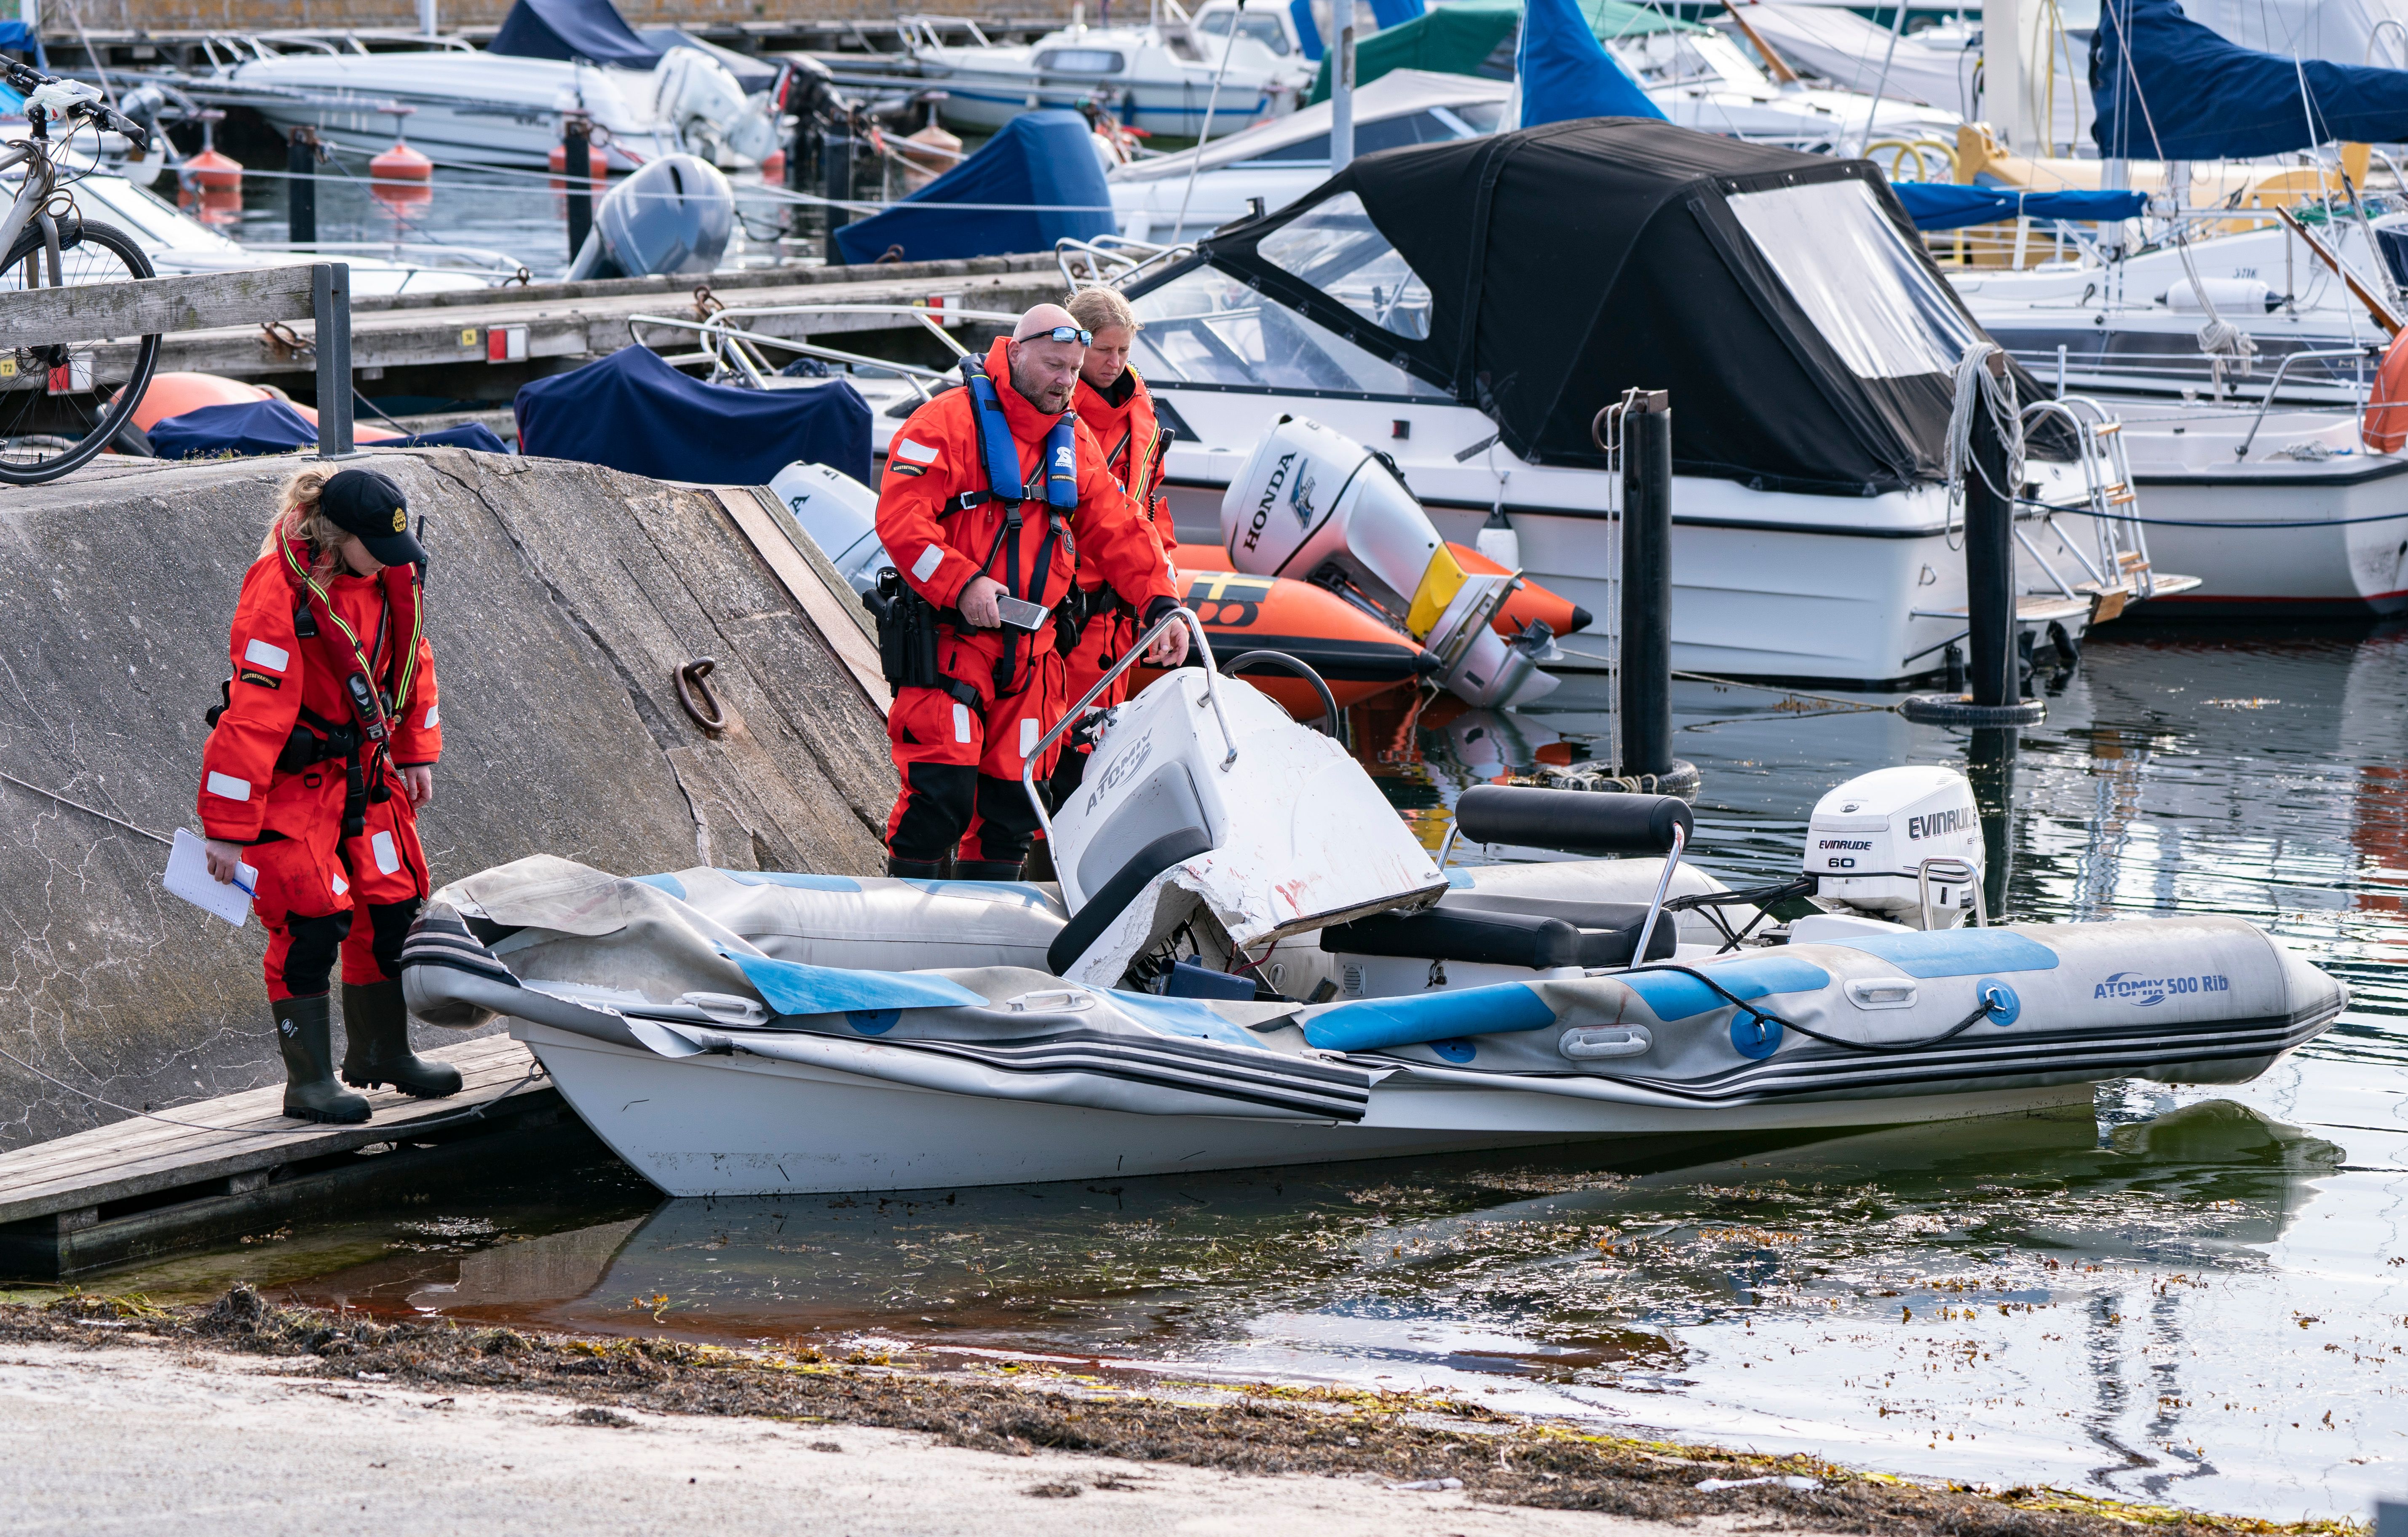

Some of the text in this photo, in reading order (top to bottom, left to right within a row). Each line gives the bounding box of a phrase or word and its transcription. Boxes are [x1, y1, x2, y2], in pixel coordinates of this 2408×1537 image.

[3, 364, 12, 372] 72
[893, 465, 923, 475] KUSTBEVAKNING
[1244, 452, 1297, 553] HONDA
[242, 673, 276, 687] KUSTBEVAKNING
[1085, 727, 1153, 817] ATOMIX
[1819, 840, 1872, 850] EVINRUDE
[1828, 857, 1856, 869] 60
[2094, 975, 2228, 999] ATOMIX 500 Rib
